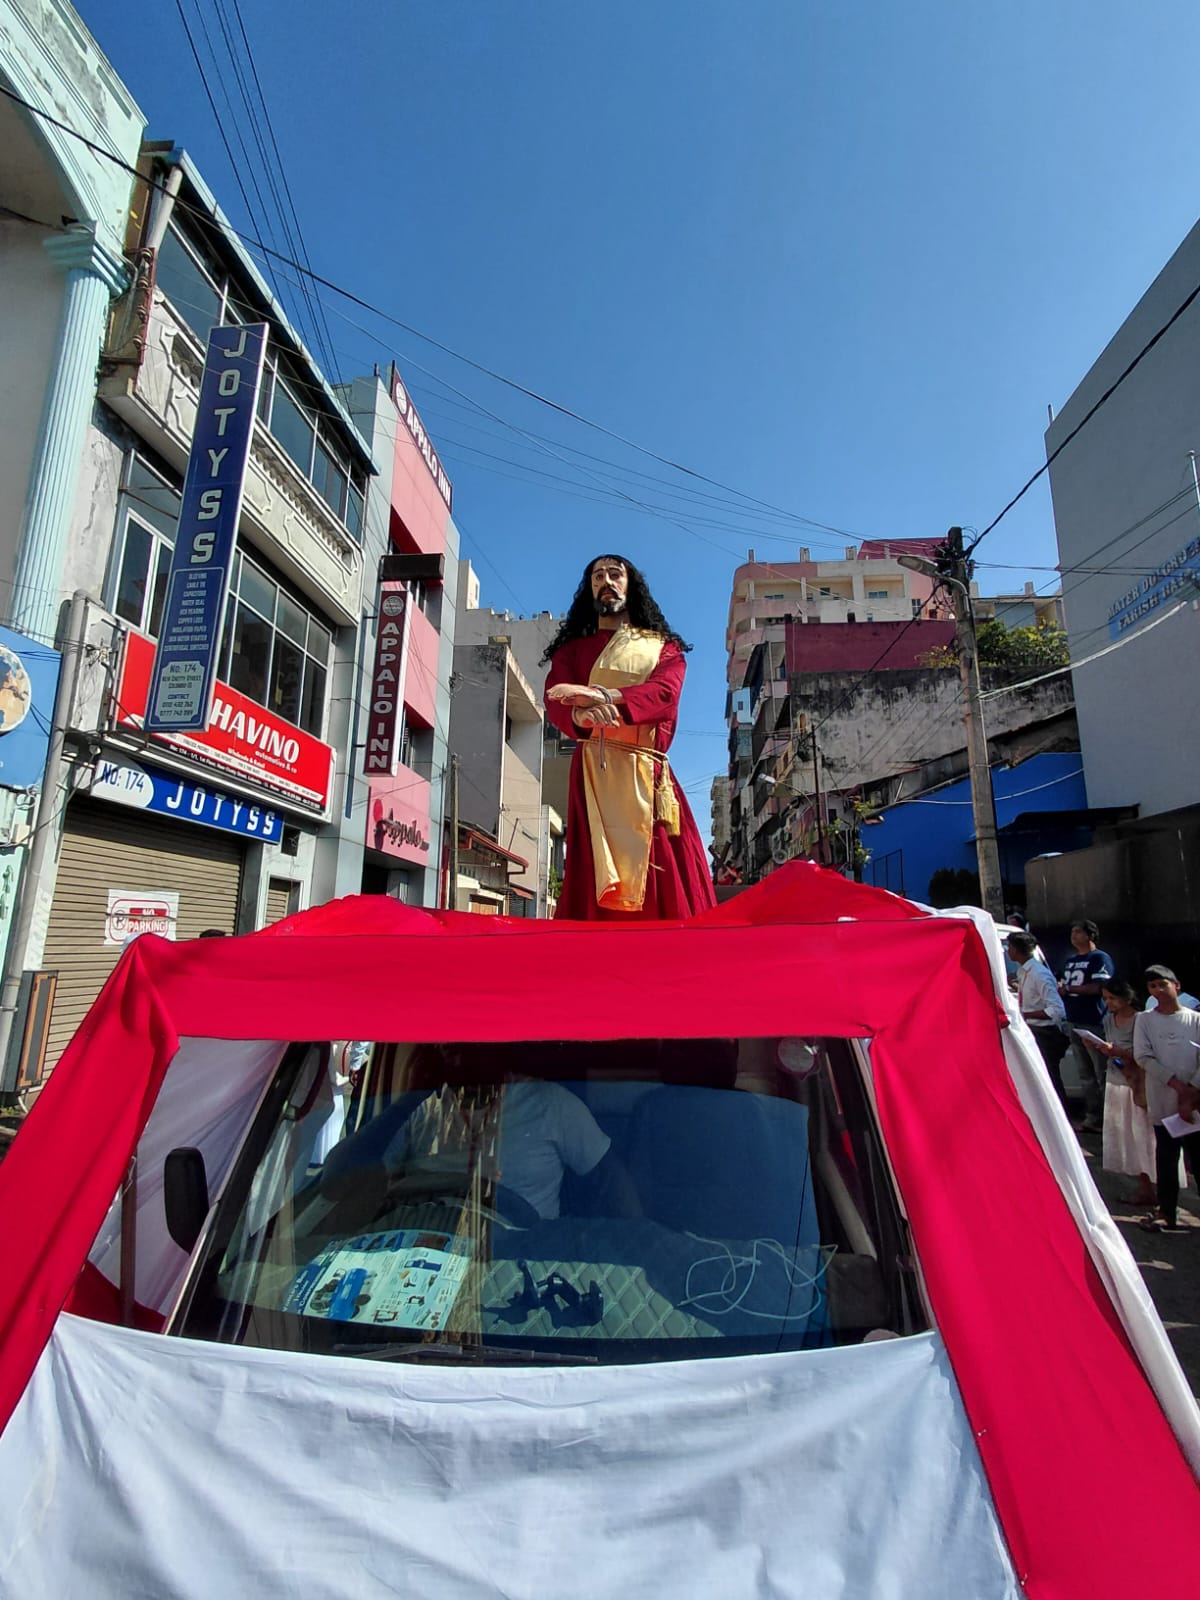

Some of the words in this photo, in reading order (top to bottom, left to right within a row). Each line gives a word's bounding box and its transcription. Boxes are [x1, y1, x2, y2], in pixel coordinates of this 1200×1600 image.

[190, 329, 247, 565] JOTYSS
[406, 405, 438, 478] APPALO
[438, 465, 451, 506] INN
[184, 663, 197, 673] 174
[372, 621, 401, 715] APPALO
[209, 698, 300, 764] HAVINO
[367, 722, 391, 769] INN
[124, 769, 145, 792] 174
[166, 780, 275, 837] JOTYSS
[127, 920, 166, 933] PARKING
